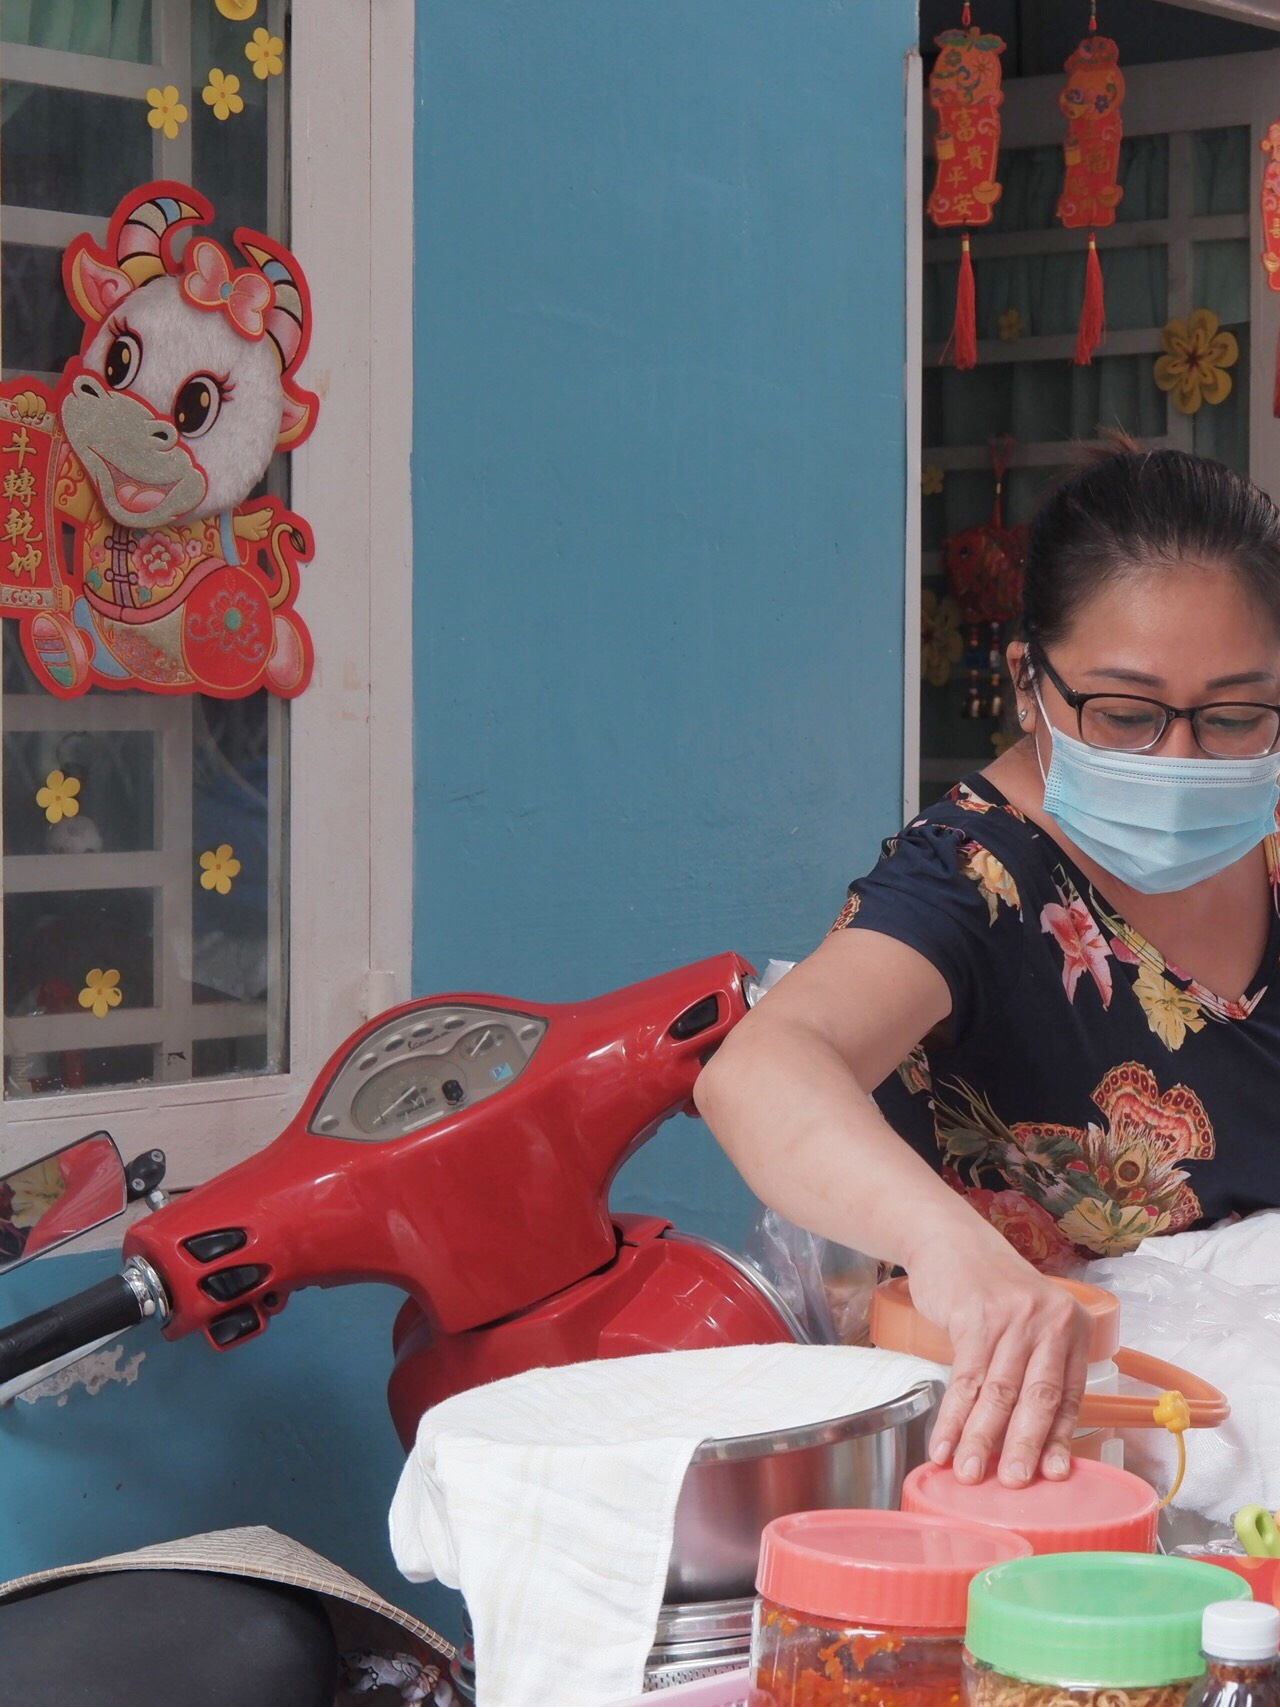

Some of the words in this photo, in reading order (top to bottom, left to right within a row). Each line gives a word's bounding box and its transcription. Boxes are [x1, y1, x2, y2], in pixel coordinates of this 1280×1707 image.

[945, 107, 988, 216] 富貴平安
[1, 427, 43, 585] 牛轉乾坤
